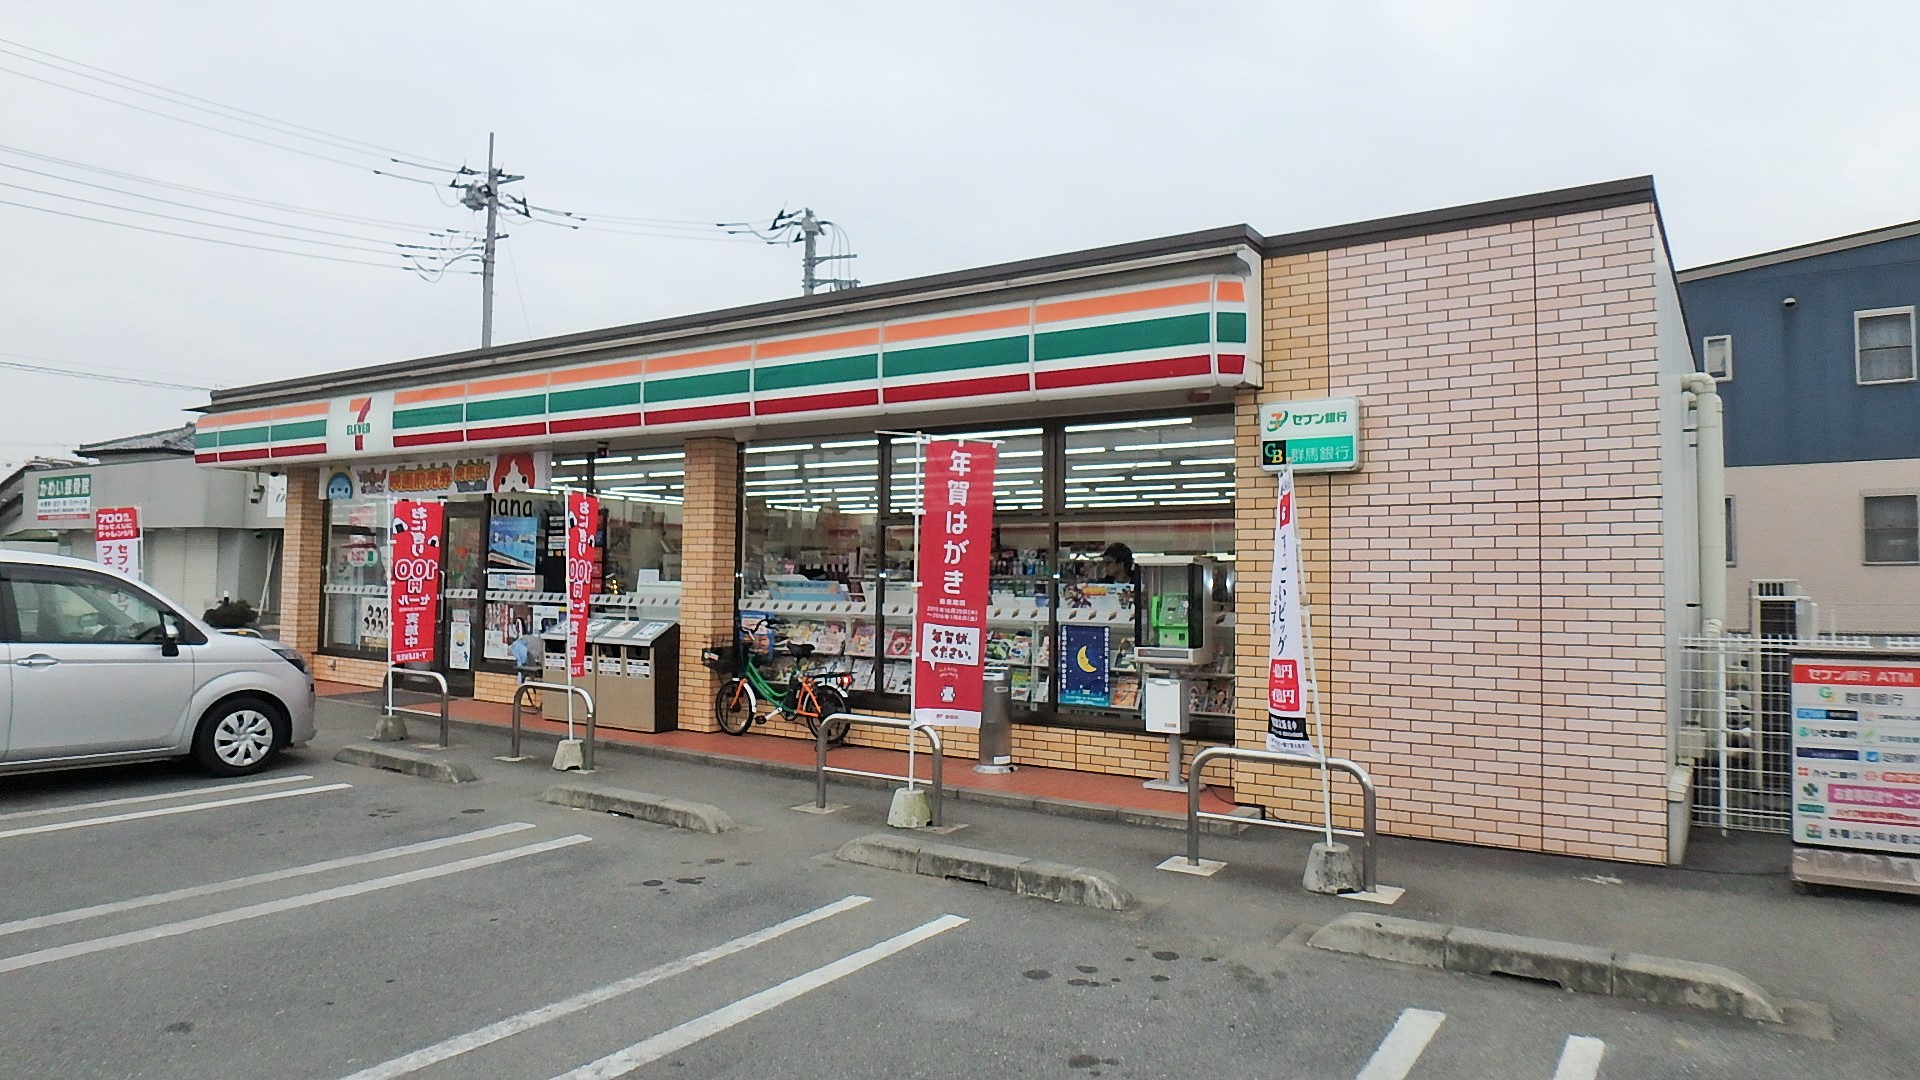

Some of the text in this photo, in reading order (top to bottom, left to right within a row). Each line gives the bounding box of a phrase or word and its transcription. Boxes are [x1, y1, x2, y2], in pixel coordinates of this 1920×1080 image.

[349, 396, 372, 450] 7
[1293, 412, 1347, 425] セブン銀行
[1291, 446, 1350, 462] 群馬銀行
[943, 450, 972, 595] 年賀はがき
[1808, 669, 1914, 683] セブン銀行 ATM
